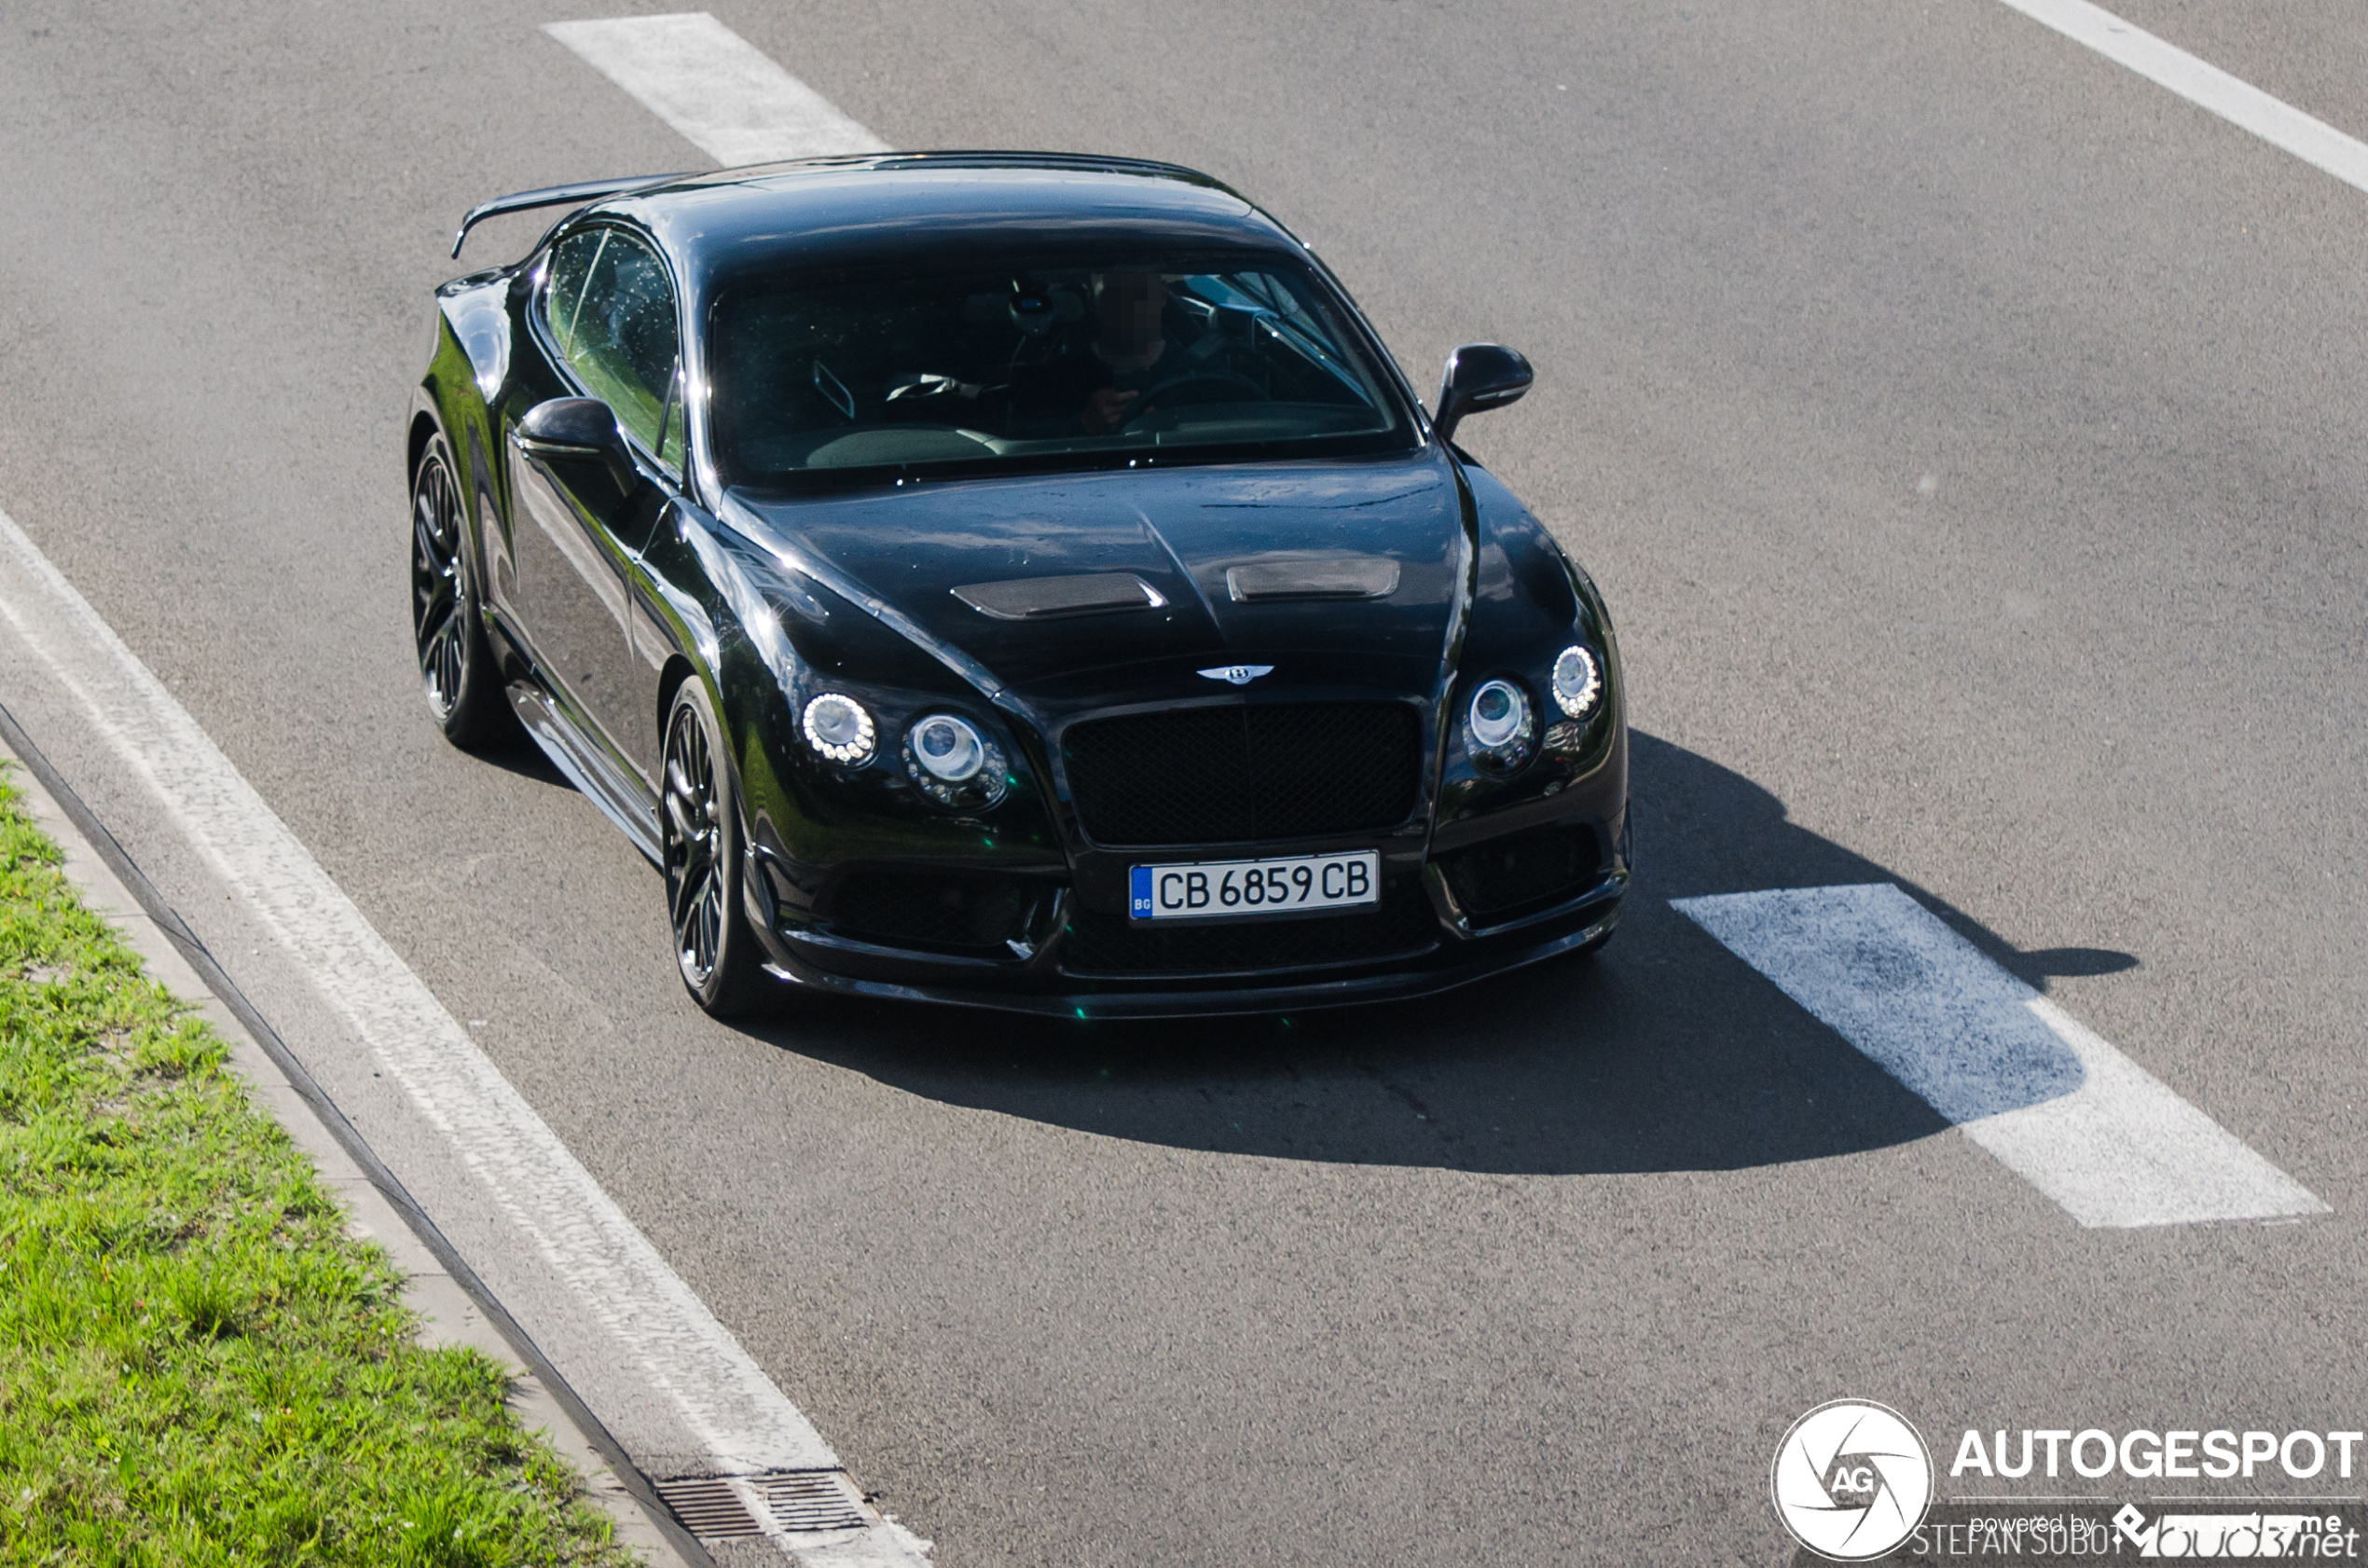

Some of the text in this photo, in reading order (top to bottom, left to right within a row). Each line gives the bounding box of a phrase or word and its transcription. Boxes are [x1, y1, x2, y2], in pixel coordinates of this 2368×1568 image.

[1160, 860, 1370, 909] CB 6859 CB
[1134, 899, 1151, 911] BG
